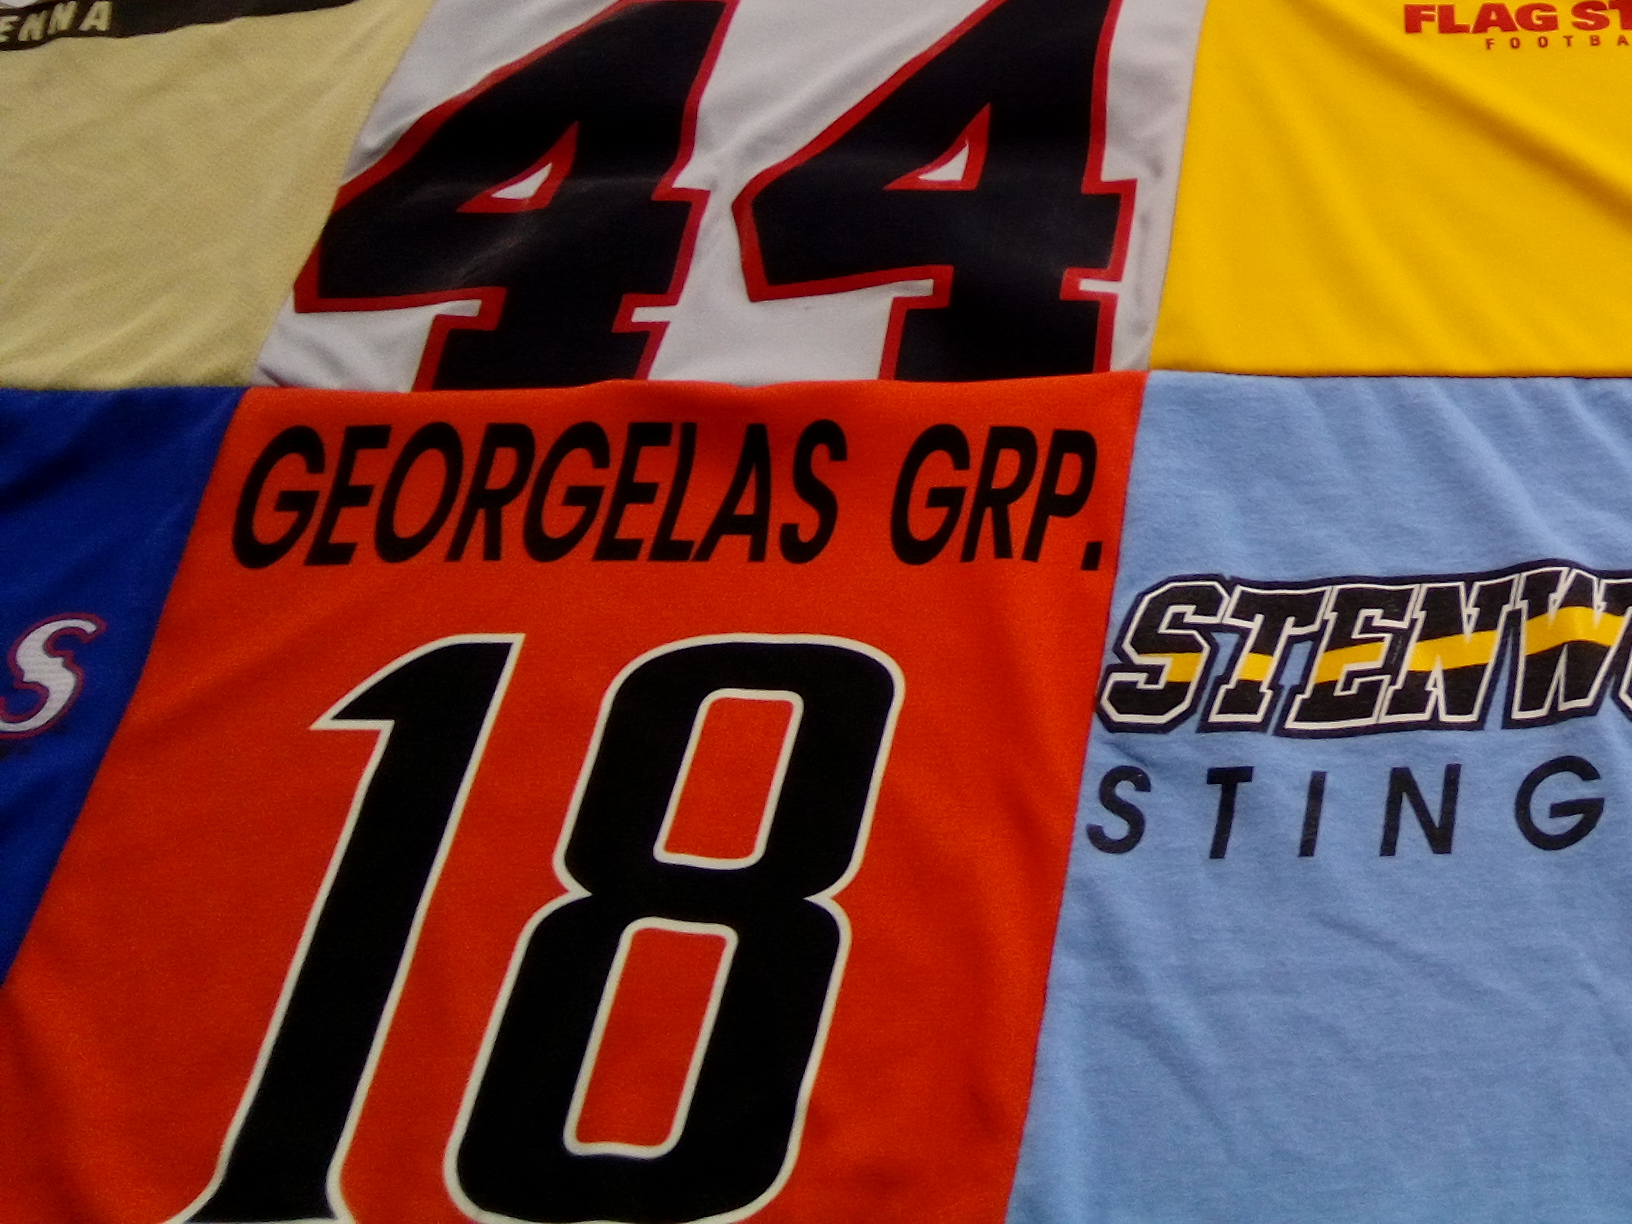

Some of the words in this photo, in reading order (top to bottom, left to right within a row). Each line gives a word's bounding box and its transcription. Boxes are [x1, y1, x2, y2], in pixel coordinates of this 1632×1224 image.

[1403, 3, 1559, 34] FLAG
[231, 419, 849, 570] GEORGELAS
[888, 424, 1105, 572] GRP.
[163, 633, 906, 1224] 18
